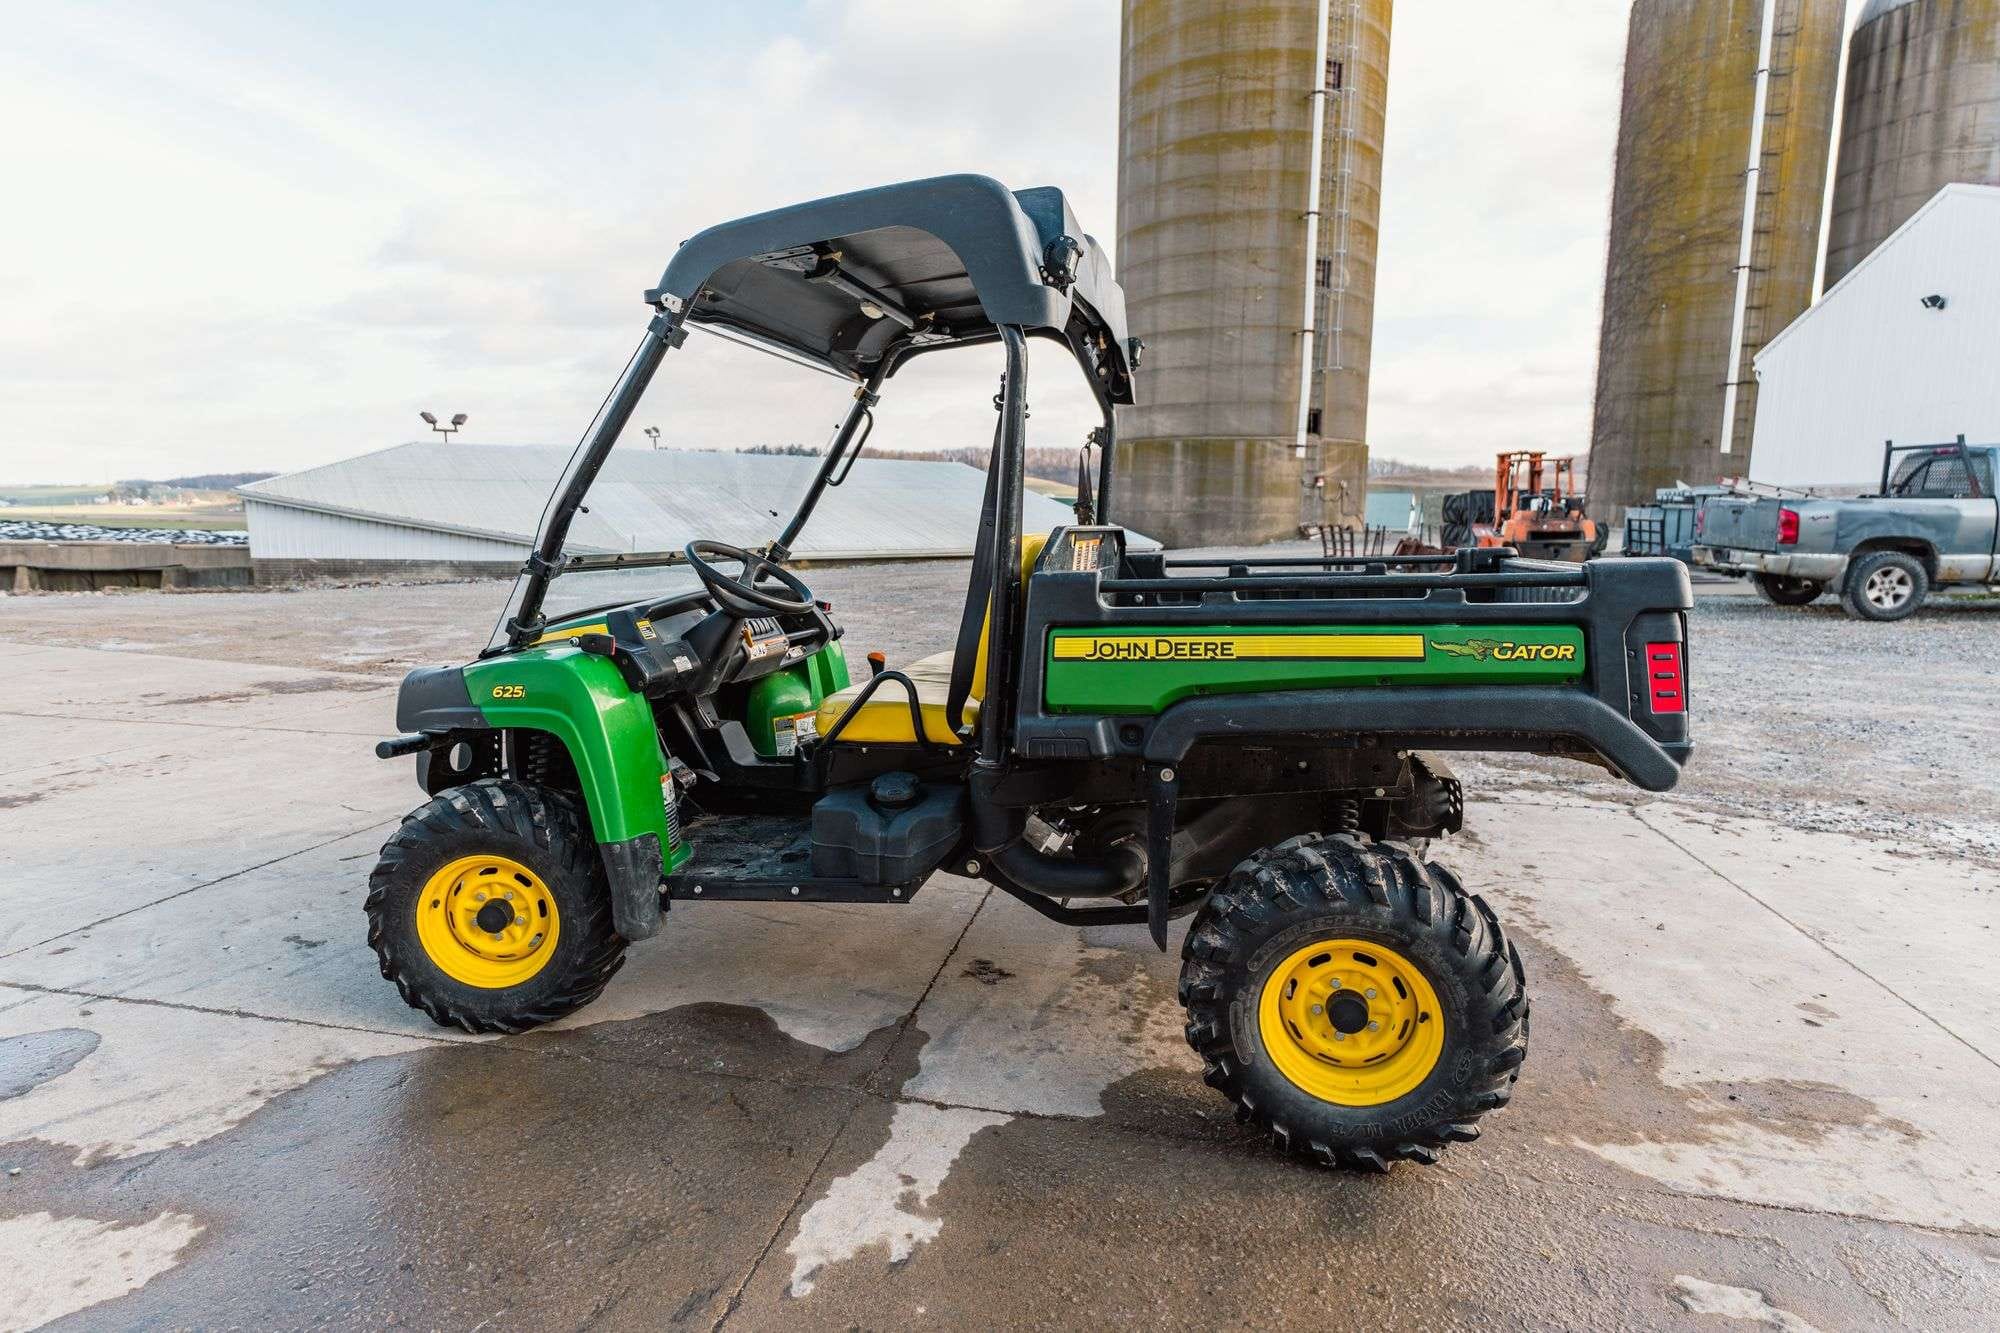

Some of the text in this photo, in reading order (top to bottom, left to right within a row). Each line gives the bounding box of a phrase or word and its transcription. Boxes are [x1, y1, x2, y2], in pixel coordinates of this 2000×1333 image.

[1085, 638, 1235, 658] JOHN DEERE
[1493, 641, 1576, 660] GATOR
